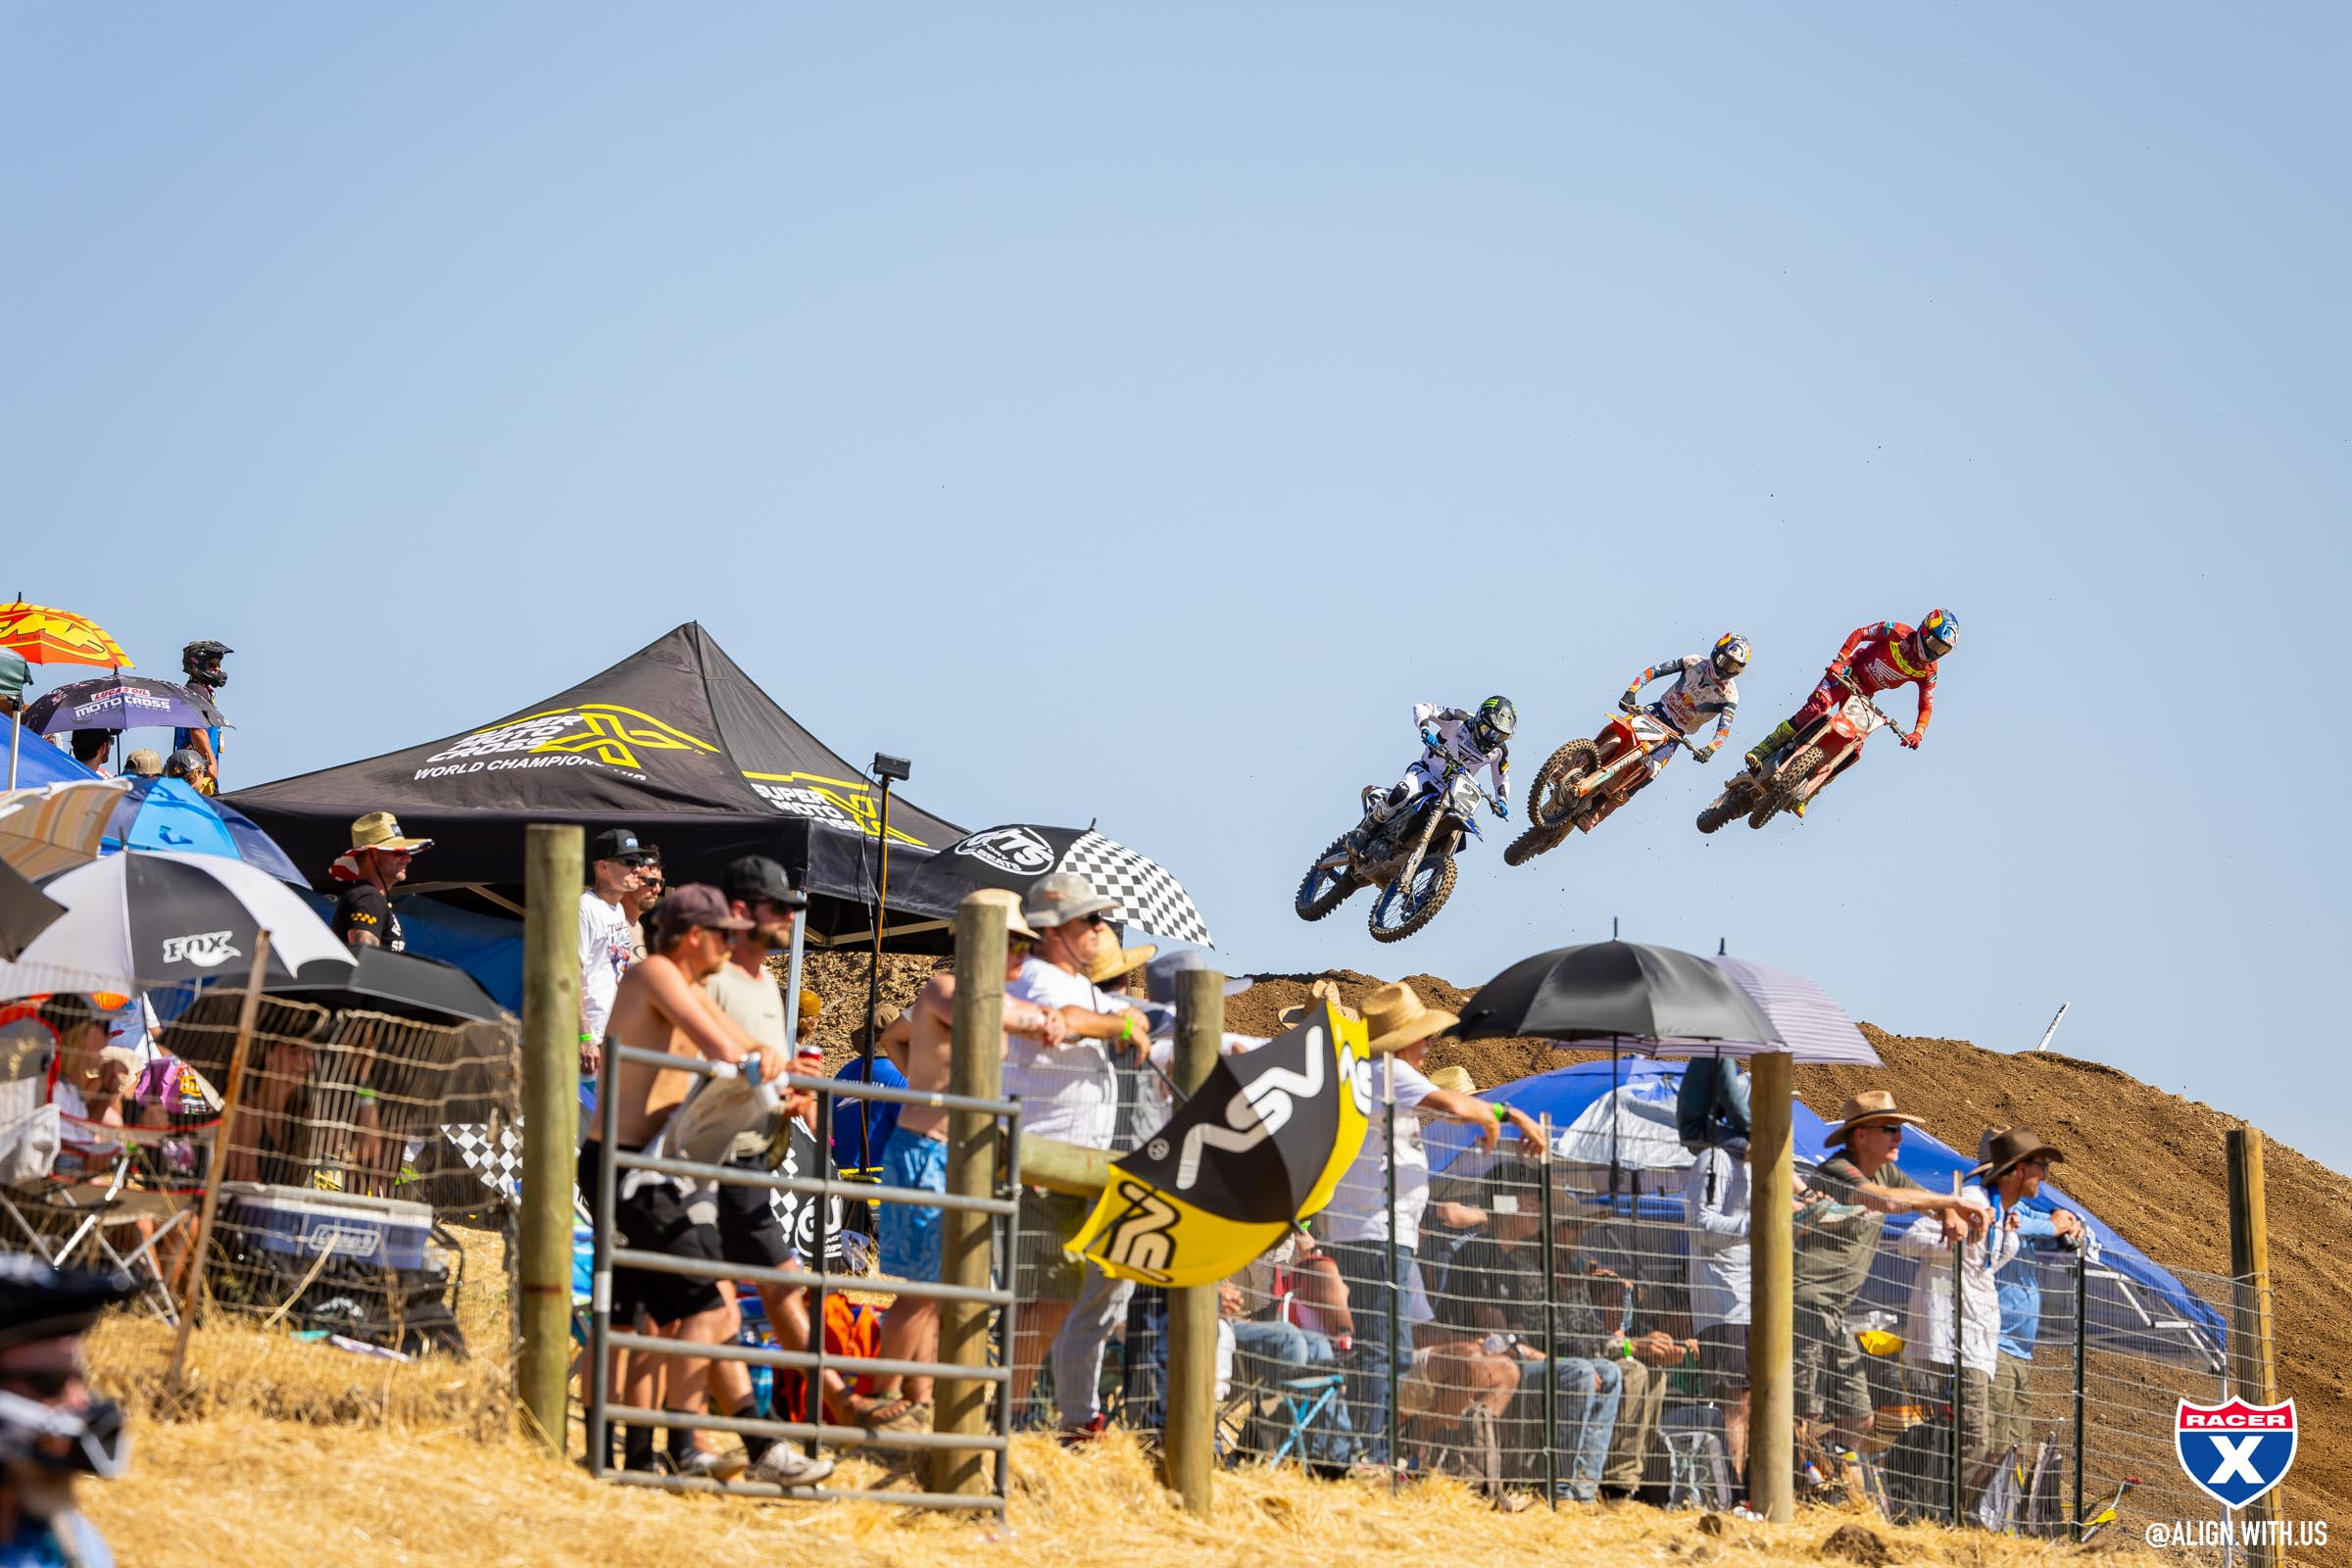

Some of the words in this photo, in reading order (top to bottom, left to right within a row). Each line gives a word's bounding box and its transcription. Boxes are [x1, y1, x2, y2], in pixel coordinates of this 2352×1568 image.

[95, 687, 129, 700] LUCAS
[426, 736, 555, 762] CROSS
[414, 761, 484, 780] WORLD
[751, 783, 832, 806] SUPER
[770, 800, 846, 819] MOTO
[976, 849, 1022, 871] SEATS
[164, 931, 242, 967] FOX
